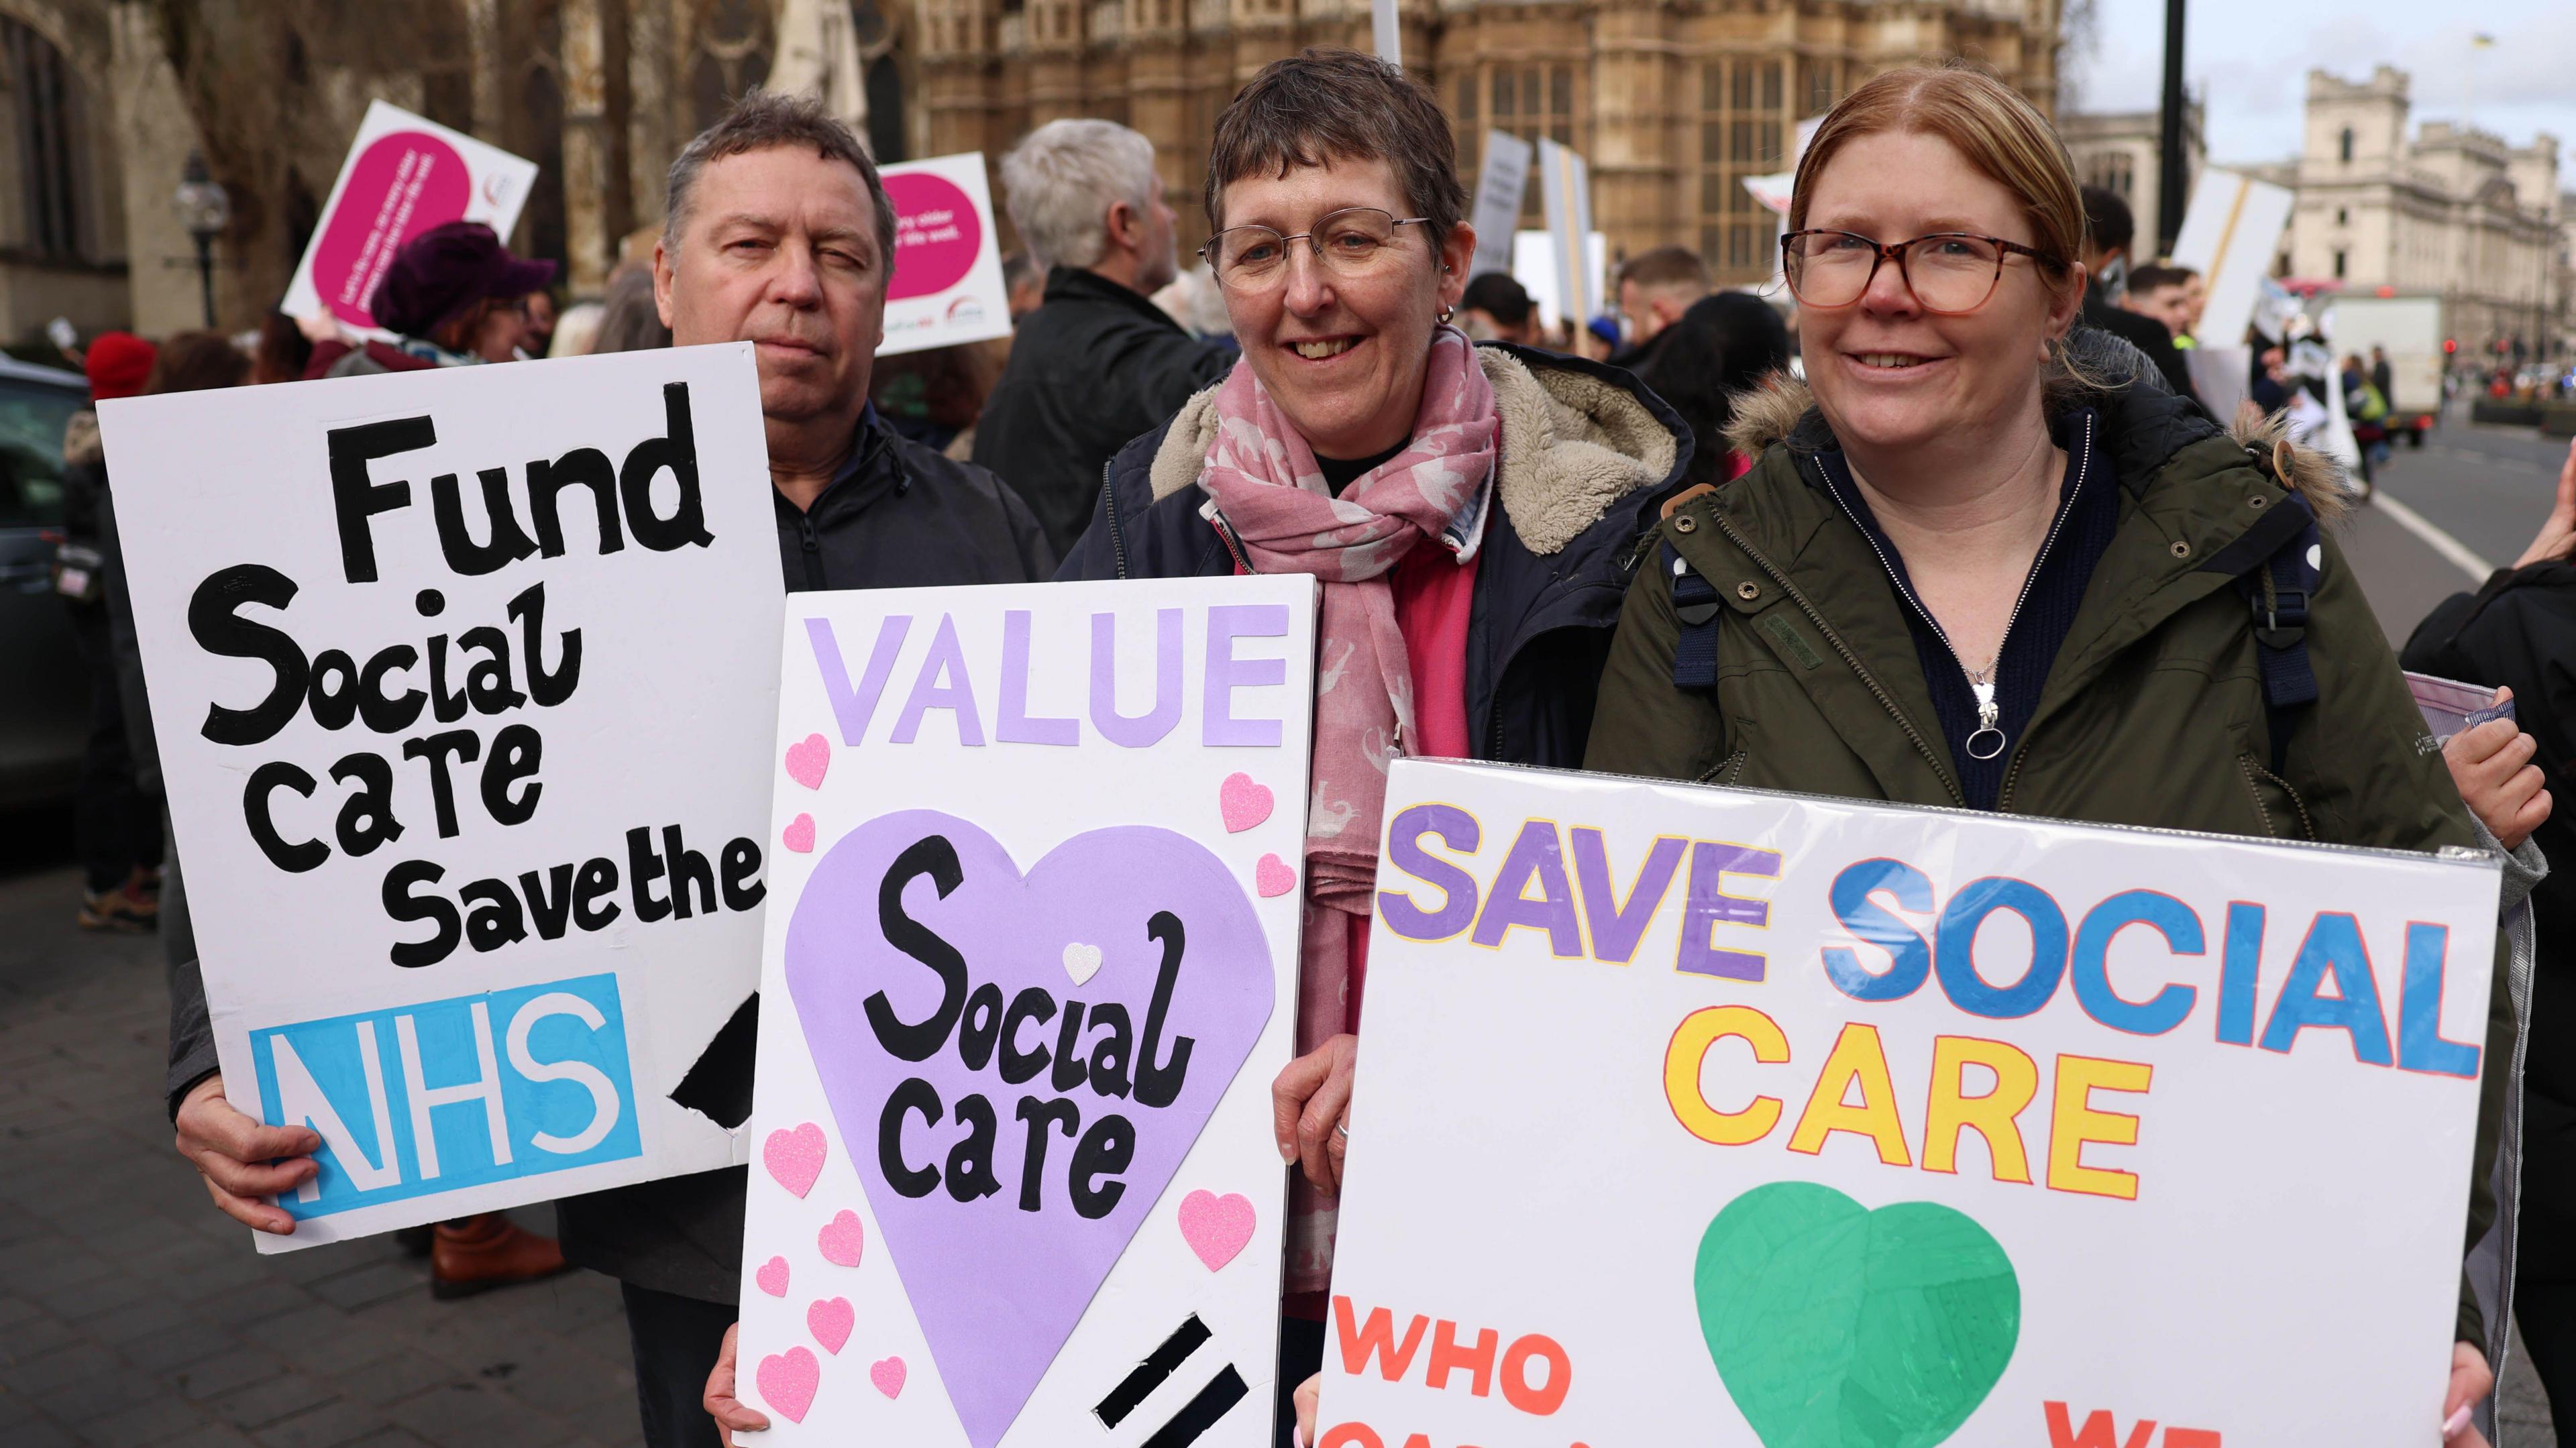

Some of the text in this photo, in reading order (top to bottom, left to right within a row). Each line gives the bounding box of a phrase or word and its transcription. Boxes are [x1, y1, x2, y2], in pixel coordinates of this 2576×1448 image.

[327, 381, 716, 584] Fund
[188, 563, 582, 746] Social
[804, 604, 1289, 747] VALUE
[382, 824, 767, 968] Save the
[863, 834, 1195, 1108] Social
[1377, 801, 2481, 1080] SAVE SOCIAL
[270, 993, 621, 1204] NHS
[1663, 1004, 2154, 1202] CARE
[1332, 1295, 1572, 1416] WHO
